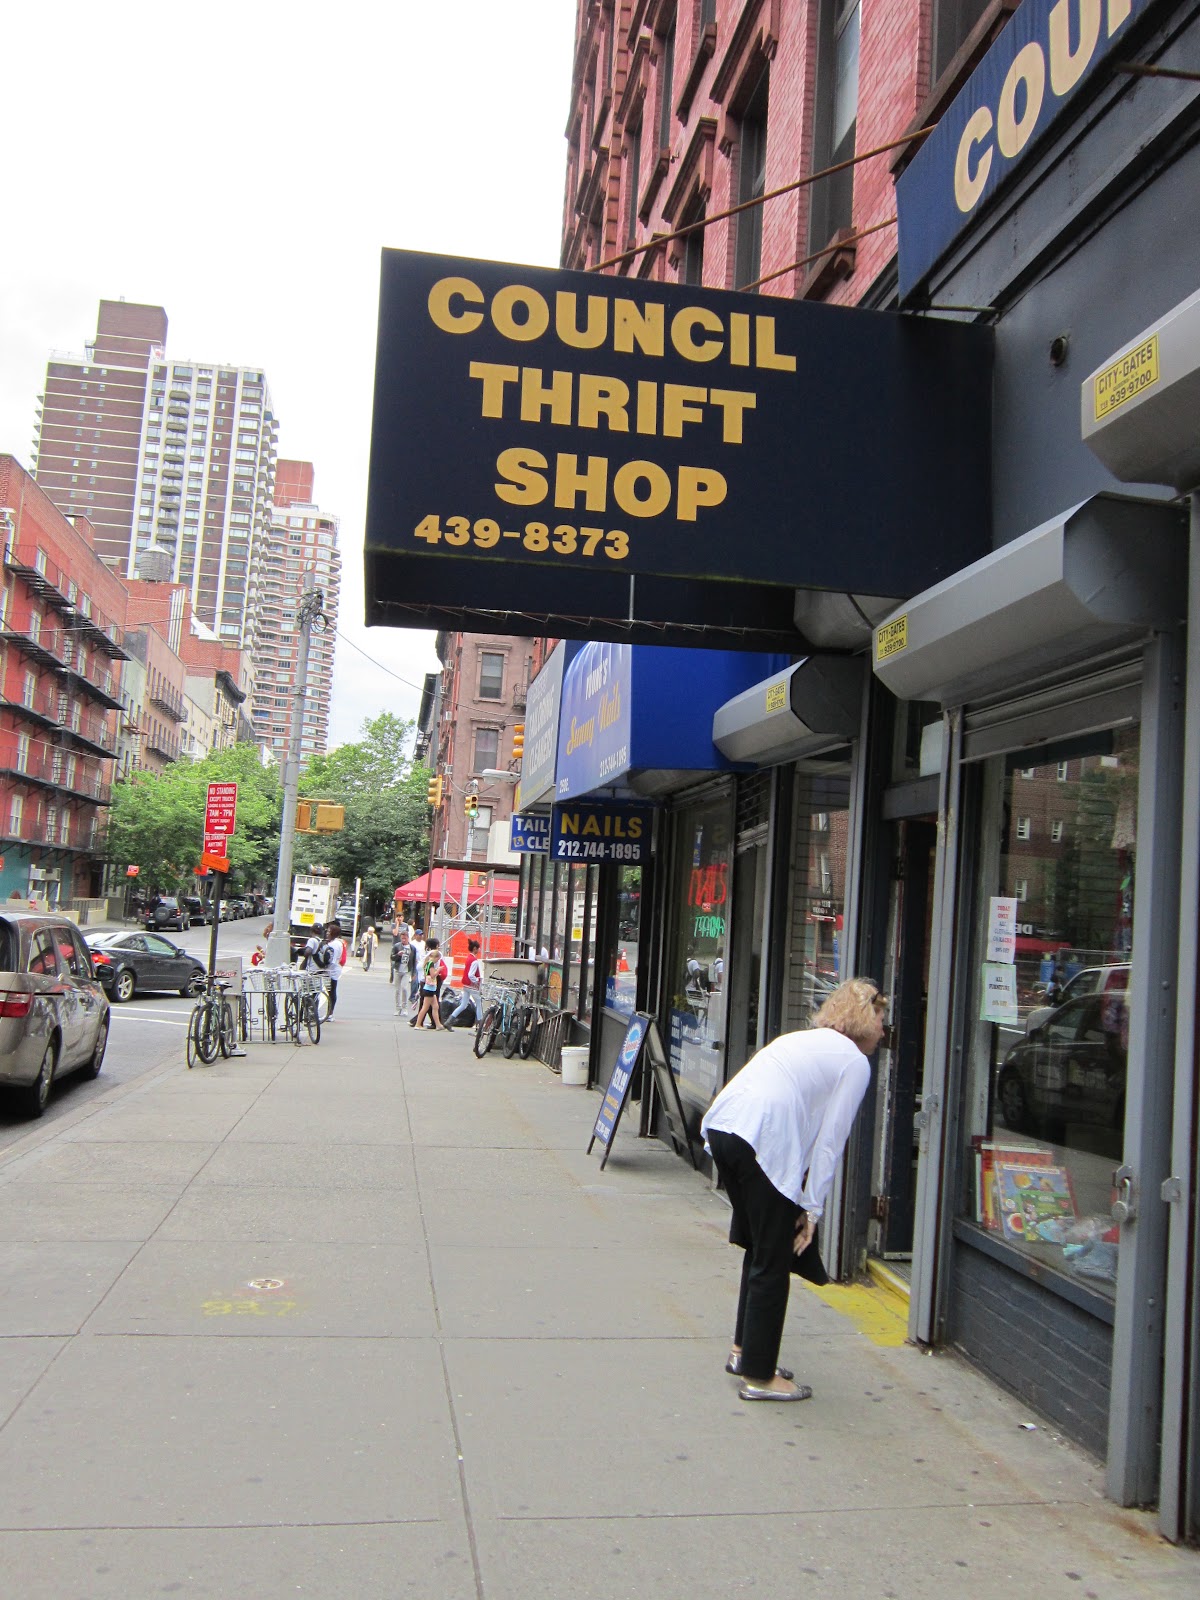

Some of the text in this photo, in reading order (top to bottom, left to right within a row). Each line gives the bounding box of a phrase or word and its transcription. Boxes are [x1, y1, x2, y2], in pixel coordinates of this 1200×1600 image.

[954, 0, 1131, 212] COU
[428, 276, 797, 372] COUNCIL
[1098, 343, 1153, 395] CITY-GATES
[469, 361, 757, 444] THRIFT
[494, 447, 728, 521] SHOP
[414, 514, 630, 560] 439-8373
[209, 787, 235, 795] NO STANDING
[515, 818, 551, 832] TAIL
[558, 839, 640, 860] 212.744-1895
[560, 813, 642, 838] NAILS
